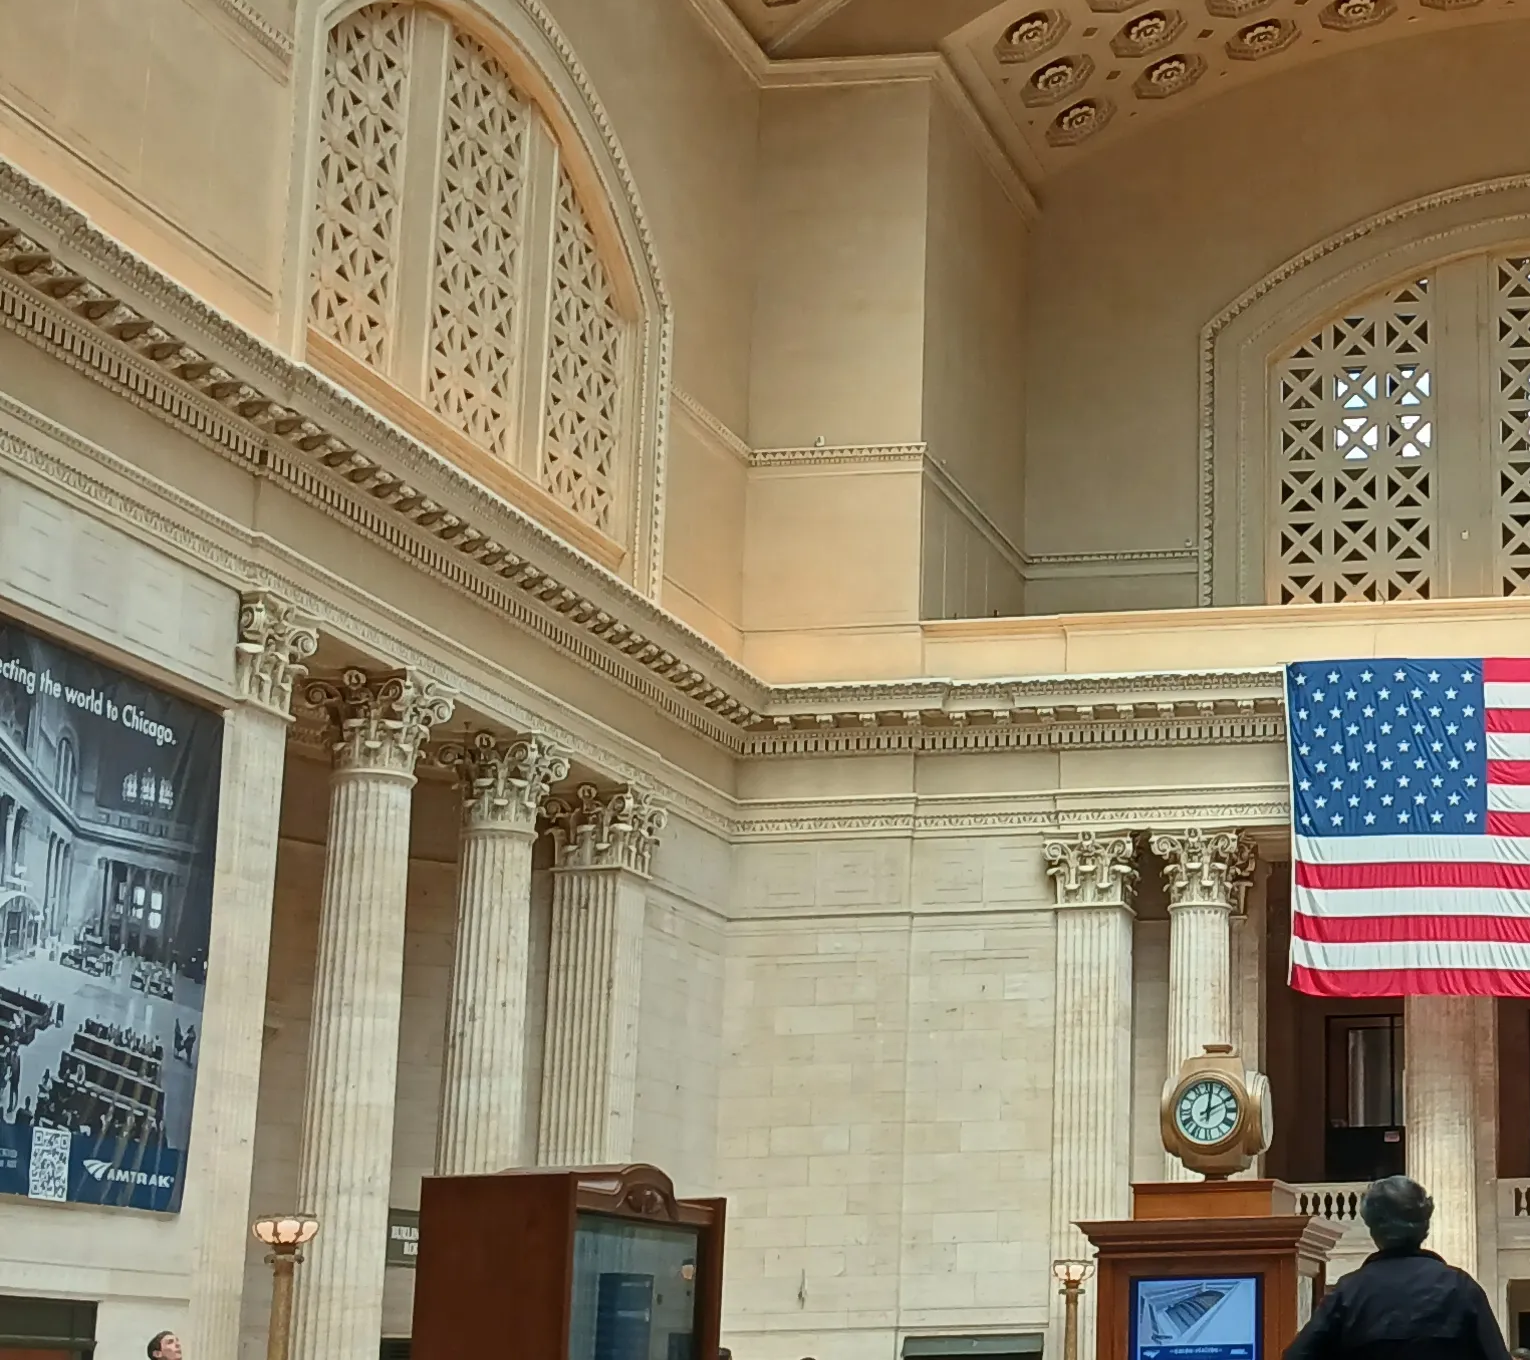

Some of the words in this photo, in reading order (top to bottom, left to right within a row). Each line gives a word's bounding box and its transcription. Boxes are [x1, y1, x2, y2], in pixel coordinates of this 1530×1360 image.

[0, 658, 36, 695] cting
[39, 668, 61, 698] the
[64, 688, 104, 716] world
[106, 699, 119, 722] to
[121, 704, 178, 746] Chicago.
